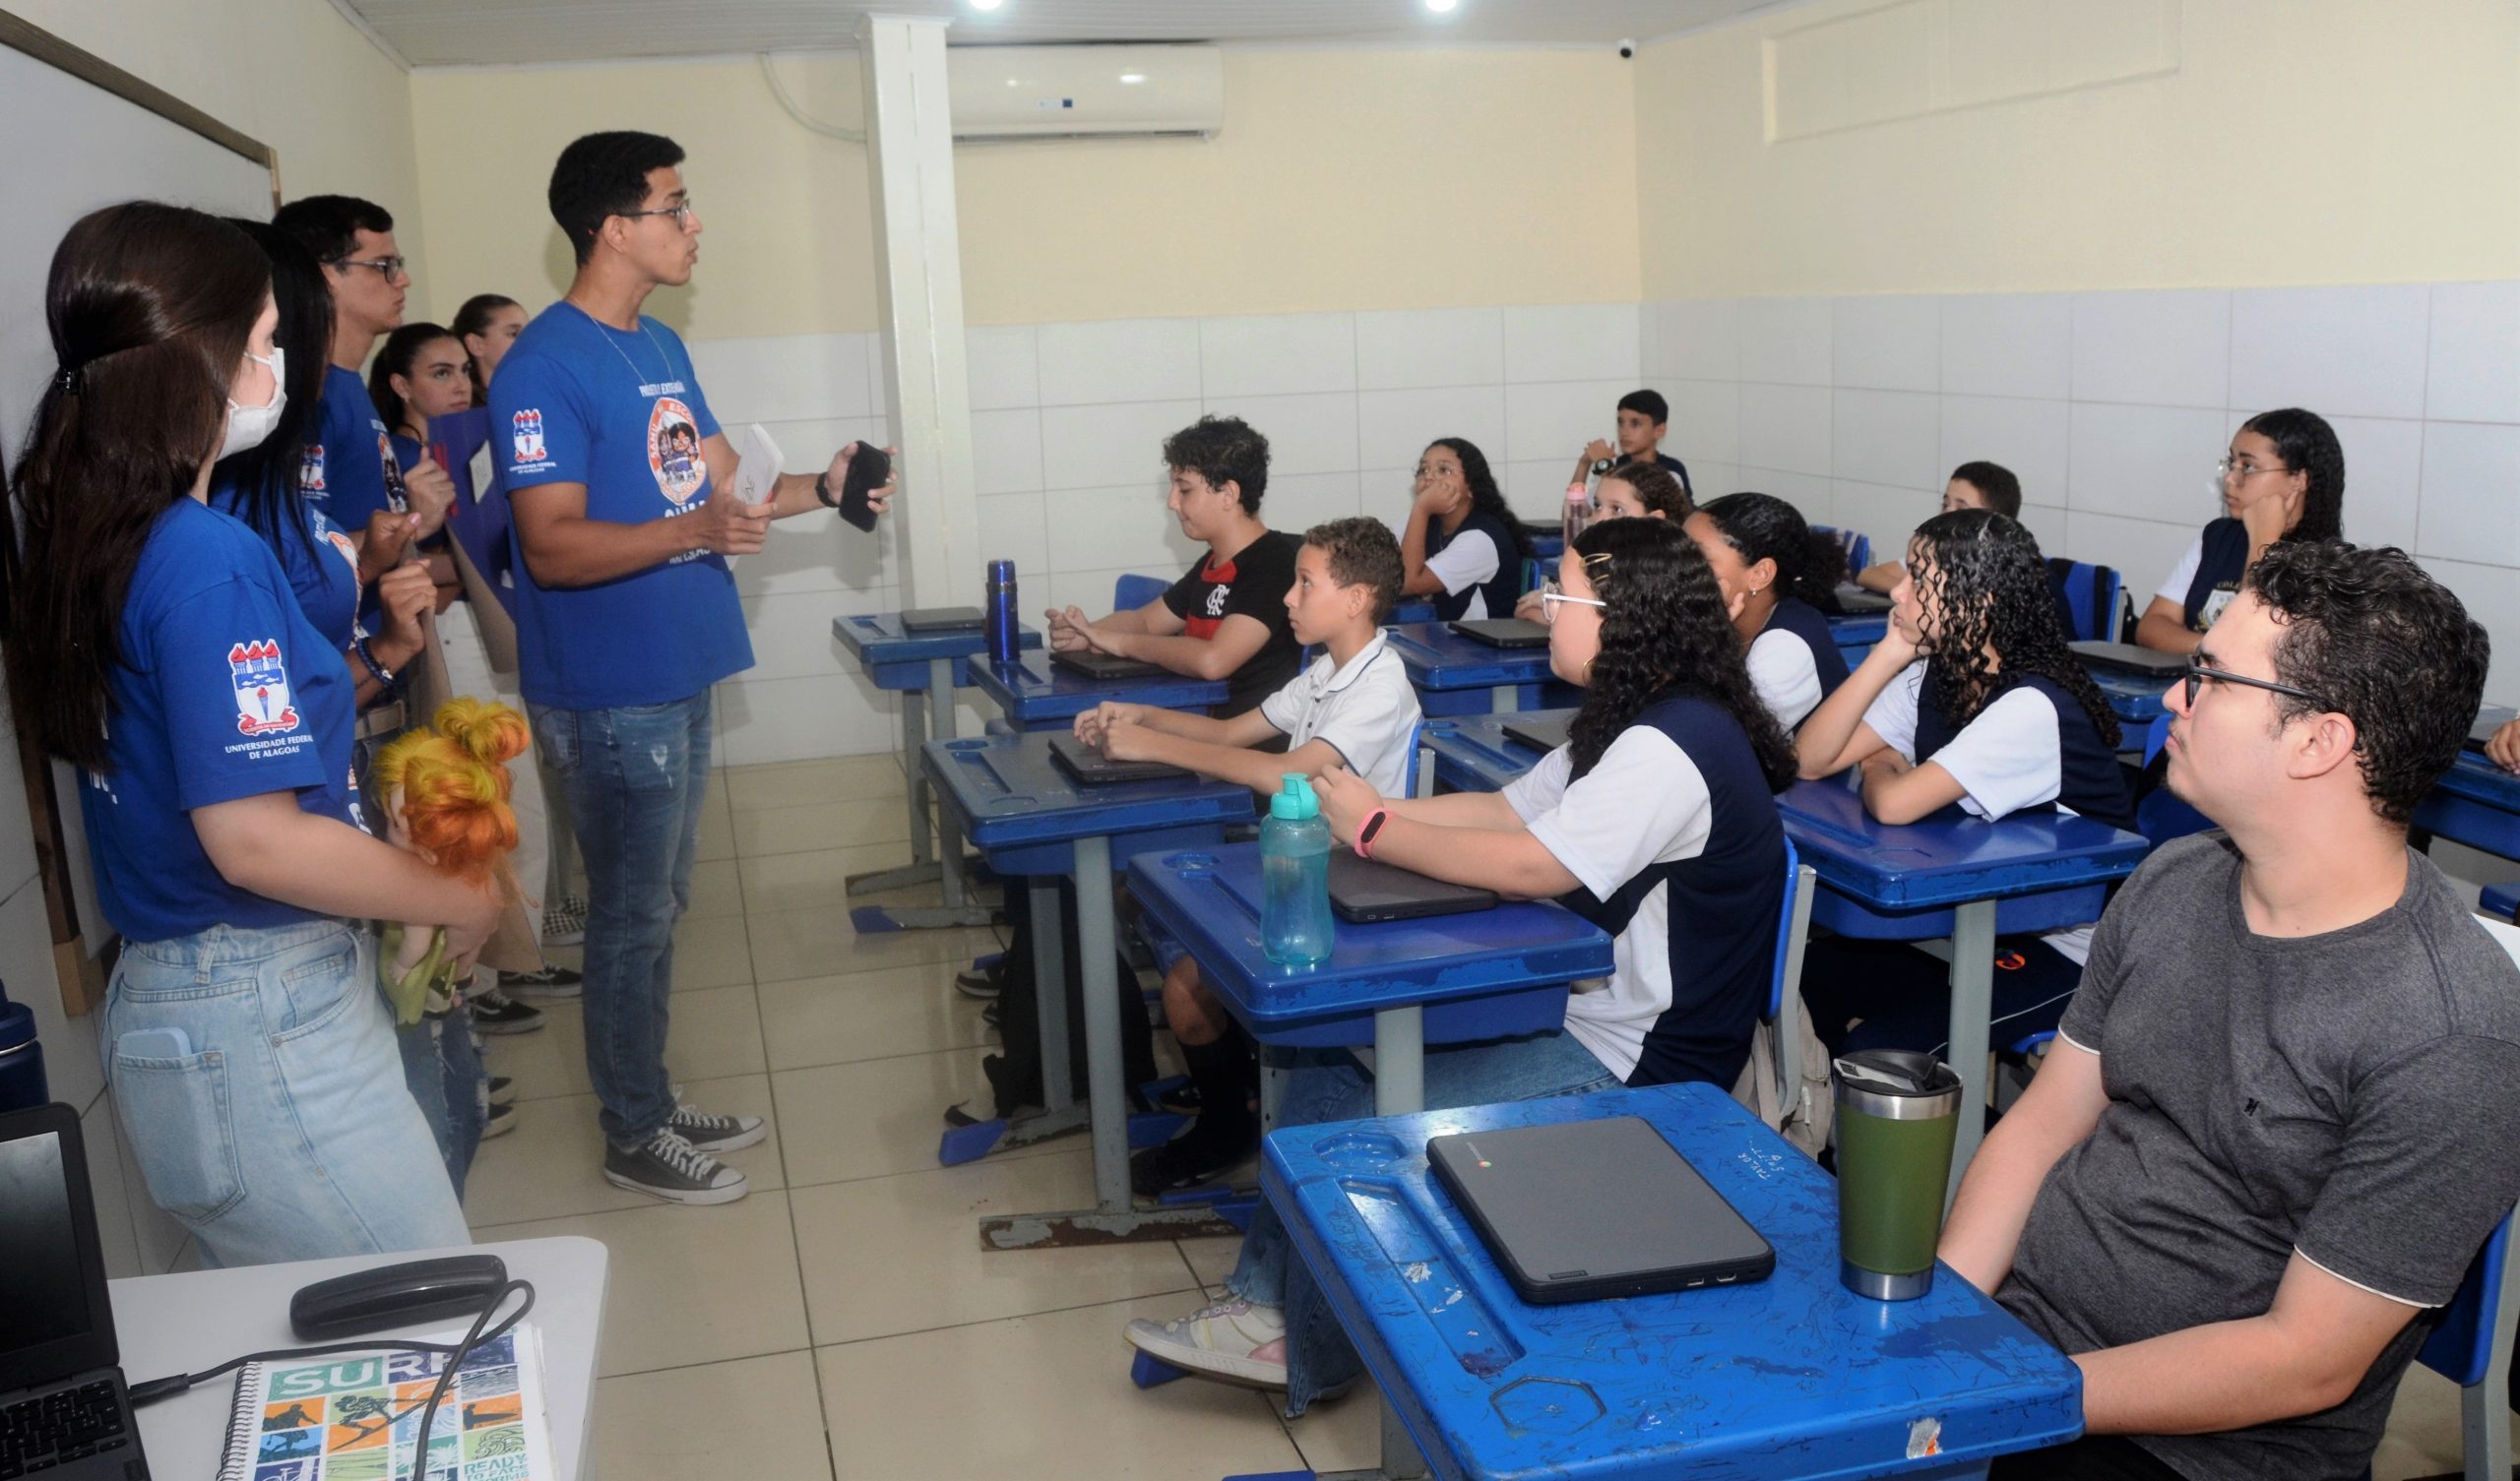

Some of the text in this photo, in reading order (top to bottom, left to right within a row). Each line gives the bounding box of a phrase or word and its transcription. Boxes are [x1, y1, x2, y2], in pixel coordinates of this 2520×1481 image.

[224, 738, 286, 754] UNIVERSIDADE
[248, 746, 300, 760] DE ALAGOAS
[464, 1452, 527, 1475] READY
